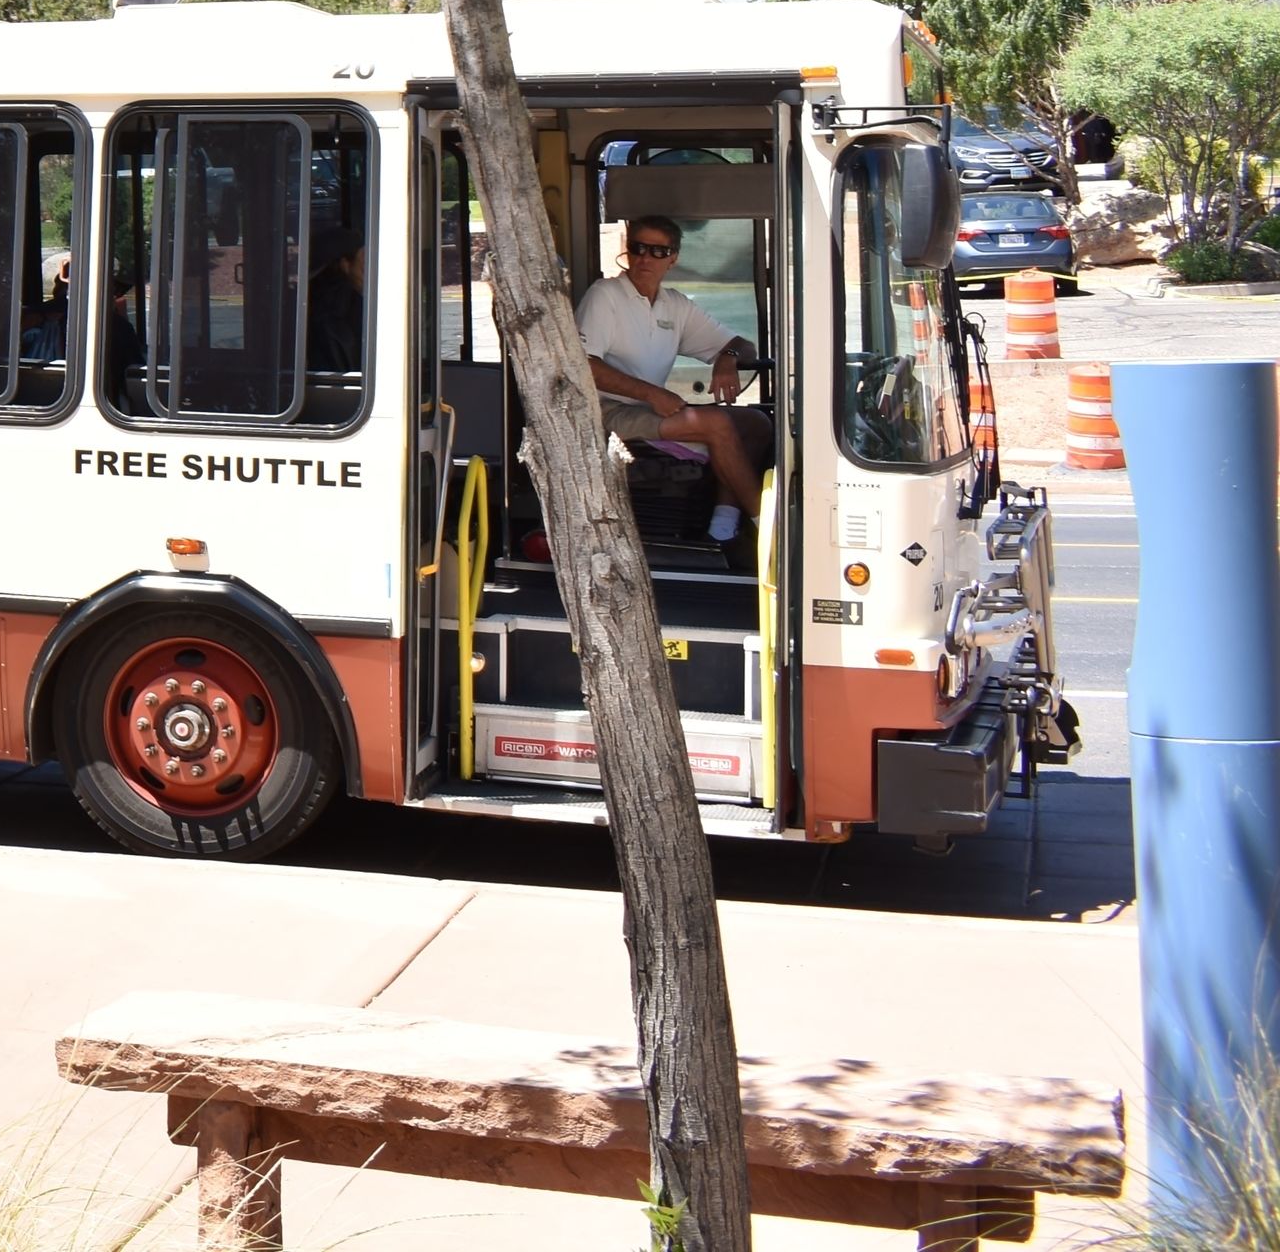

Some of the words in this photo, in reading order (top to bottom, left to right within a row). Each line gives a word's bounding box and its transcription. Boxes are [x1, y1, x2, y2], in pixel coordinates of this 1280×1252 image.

[332, 62, 375, 79] 20
[74, 449, 168, 478] FREE
[181, 454, 362, 488] SHUTTLE
[934, 584, 944, 612] 20
